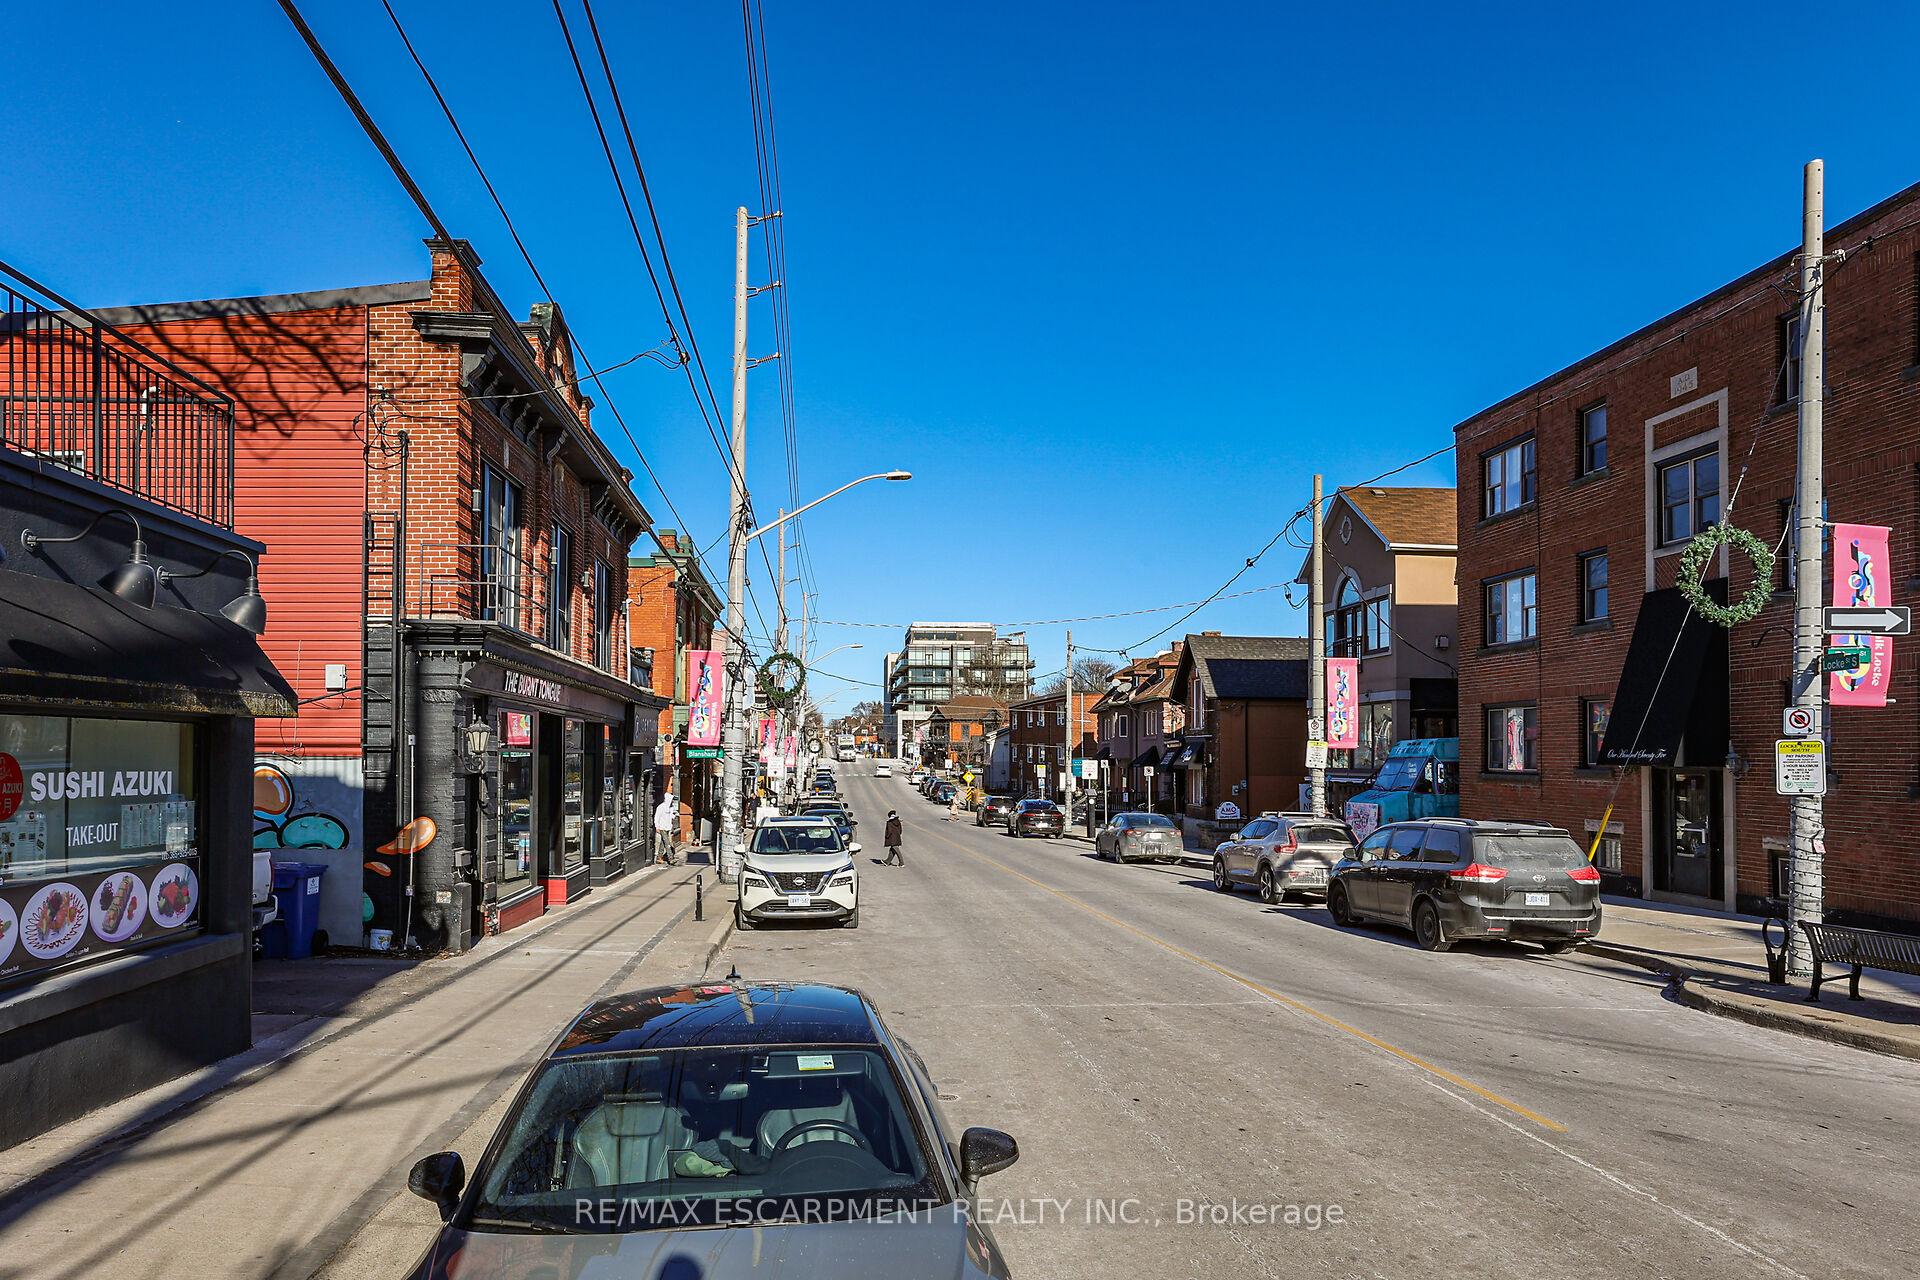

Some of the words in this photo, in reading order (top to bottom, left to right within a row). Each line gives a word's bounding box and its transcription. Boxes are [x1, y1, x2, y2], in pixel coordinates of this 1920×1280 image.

[1875, 636, 1885, 650] lk
[1823, 659, 1845, 670] Locke
[1851, 656, 1858, 667] S
[1871, 652, 1885, 687] Locke
[505, 670, 519, 693] THE
[518, 674, 540, 697] BURNT
[539, 679, 562, 702] TONGUE
[688, 749, 717, 757] Blanshard
[2, 783, 22, 794] AZUKI
[30, 771, 105, 802] SUSHI
[111, 770, 173, 797] AZUKI
[65, 822, 119, 847] TAKE-OUT
